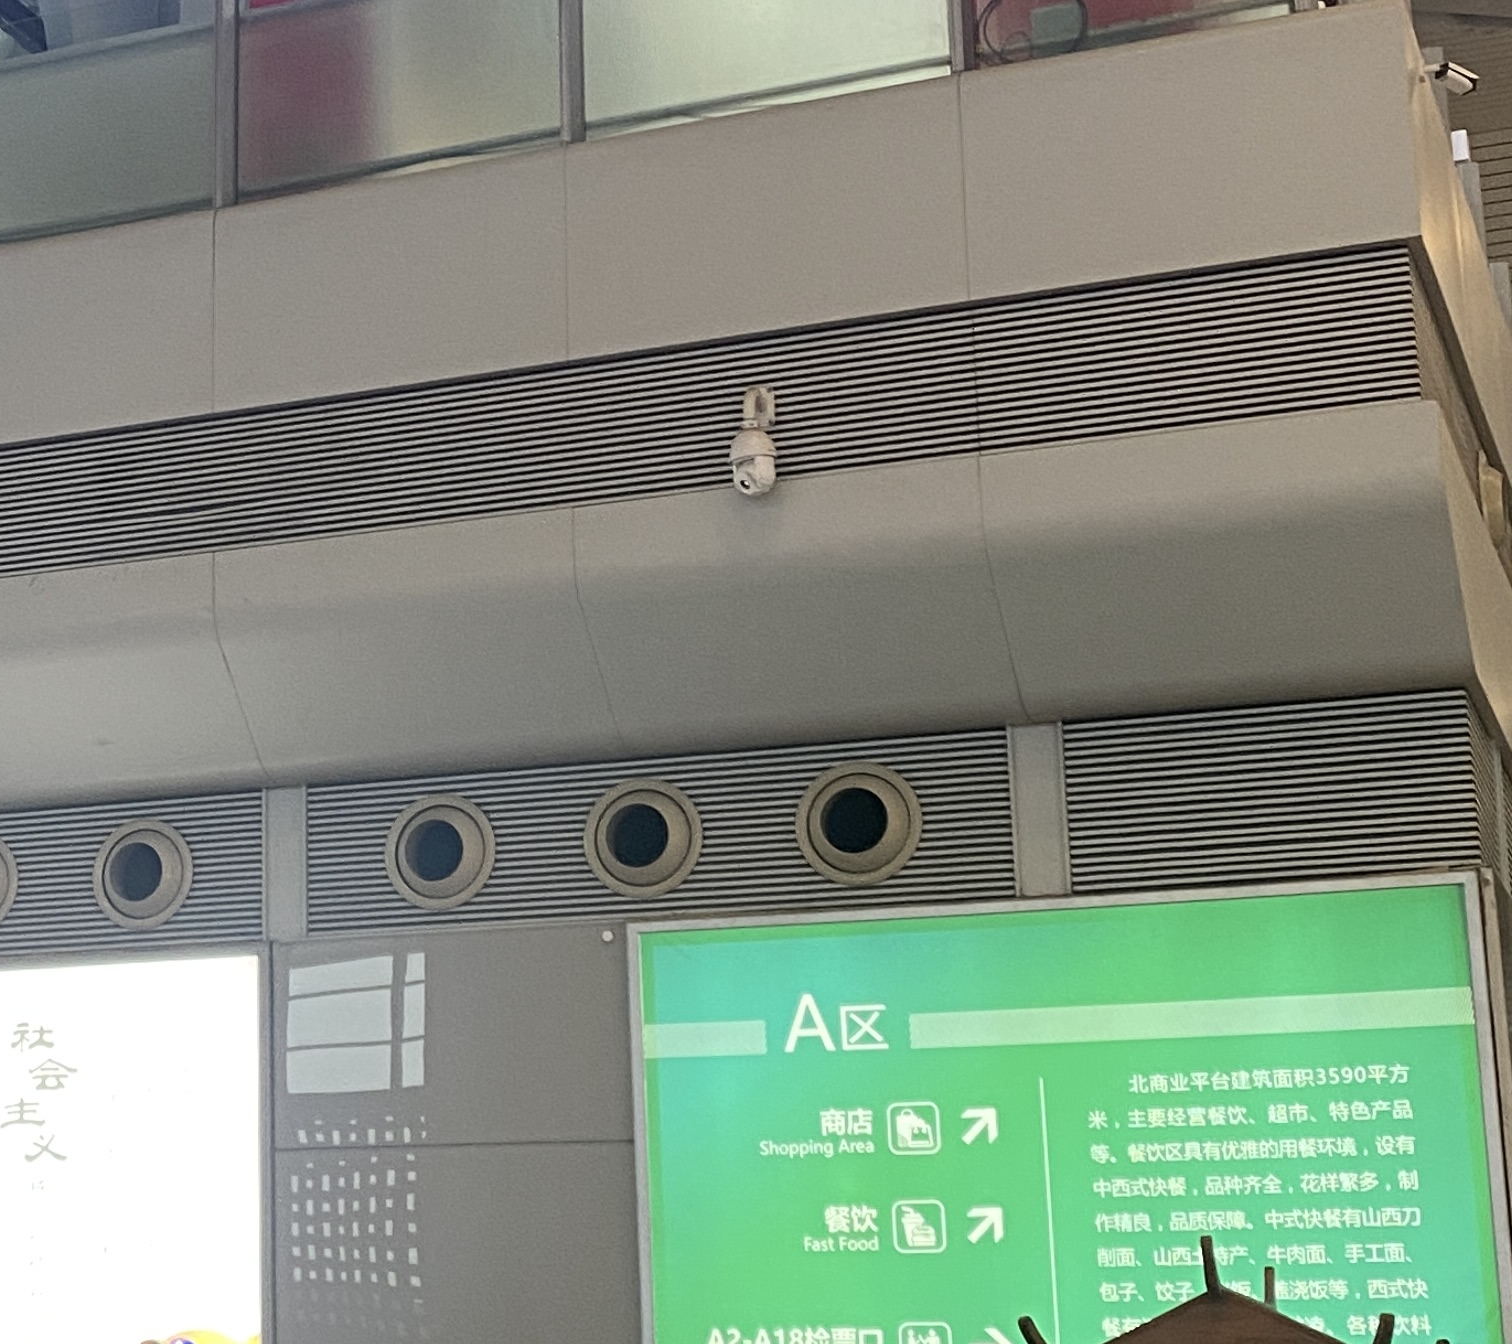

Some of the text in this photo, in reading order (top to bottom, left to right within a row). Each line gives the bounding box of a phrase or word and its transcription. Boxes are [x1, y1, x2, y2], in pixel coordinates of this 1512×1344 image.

[785, 993, 889, 1052] A区
[1128, 1064, 1409, 1094] 北商业平台建筑面积3590平方
[819, 1108, 873, 1136] 商店
[759, 1139, 875, 1158] Shopping Area
[824, 1204, 878, 1233] 餐饮
[803, 1236, 879, 1252] Fast Food
